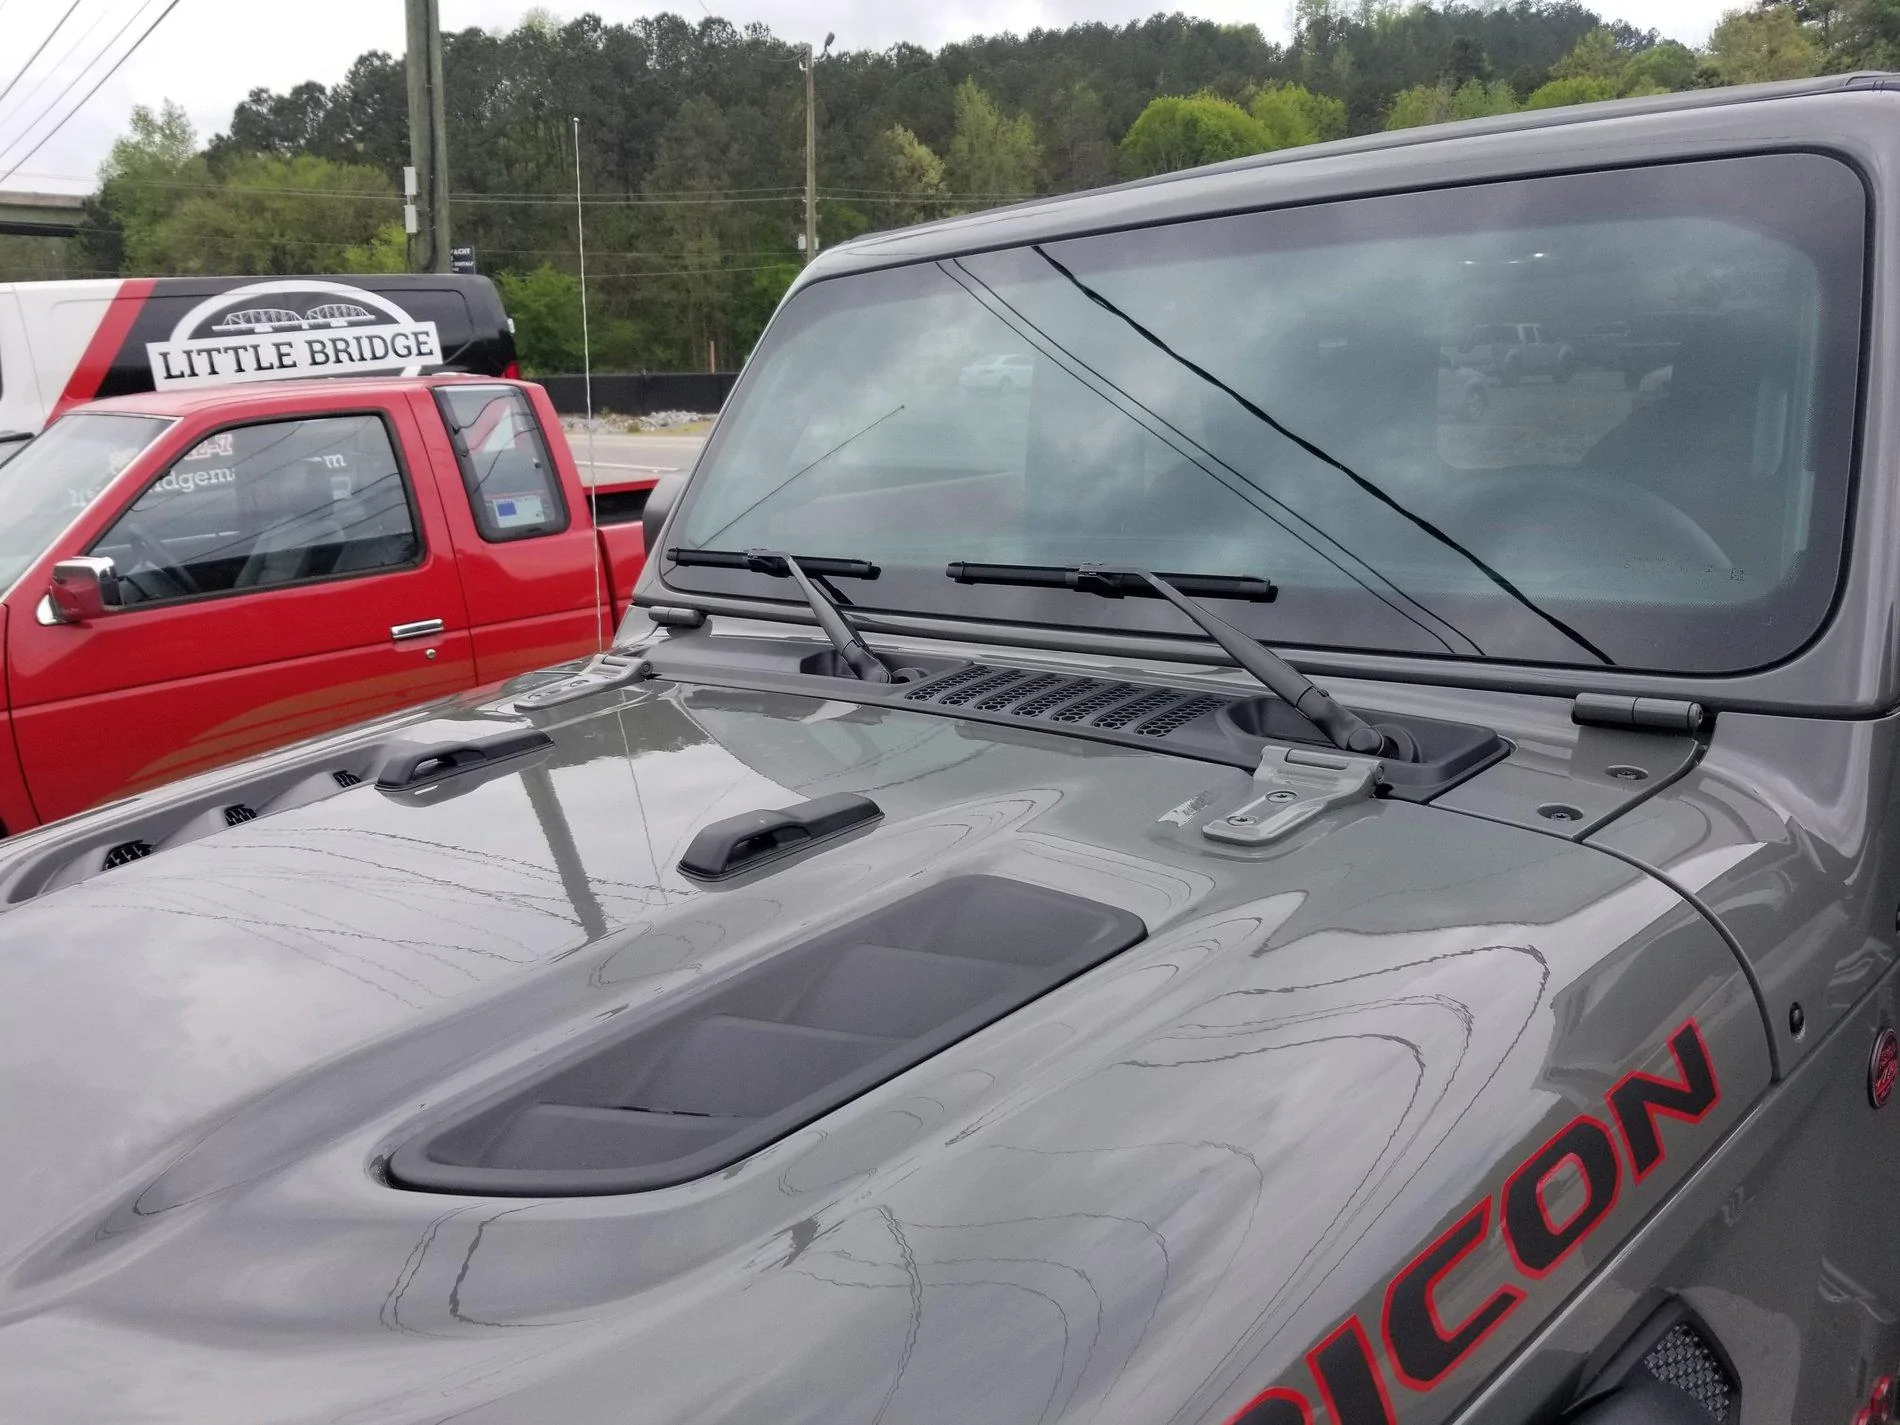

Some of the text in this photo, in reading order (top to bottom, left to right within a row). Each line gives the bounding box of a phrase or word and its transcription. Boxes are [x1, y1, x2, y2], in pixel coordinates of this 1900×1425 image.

[159, 330, 434, 380] LITTLE BRIDGE
[1219, 1015, 1722, 1425] ICON
